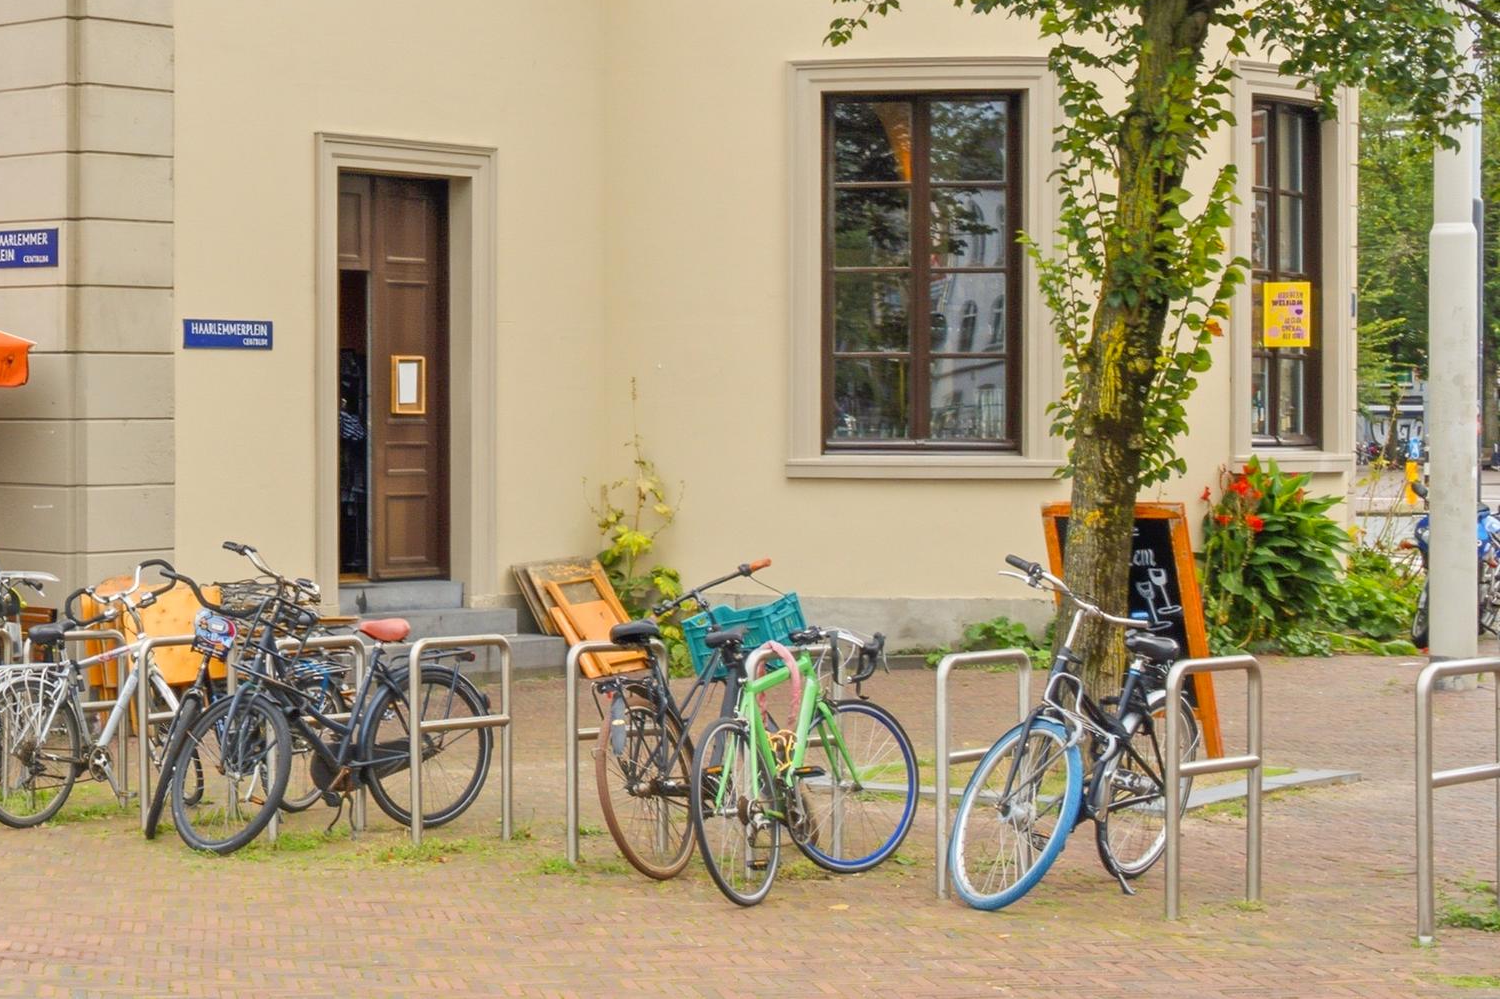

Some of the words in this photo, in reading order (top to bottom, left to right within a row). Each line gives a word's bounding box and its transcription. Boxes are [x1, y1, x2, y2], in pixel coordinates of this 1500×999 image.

[23, 255, 49, 263] CENTRUM
[191, 322, 268, 337] HAARLEMMERPLEIN
[242, 338, 268, 346] CENTRUM
